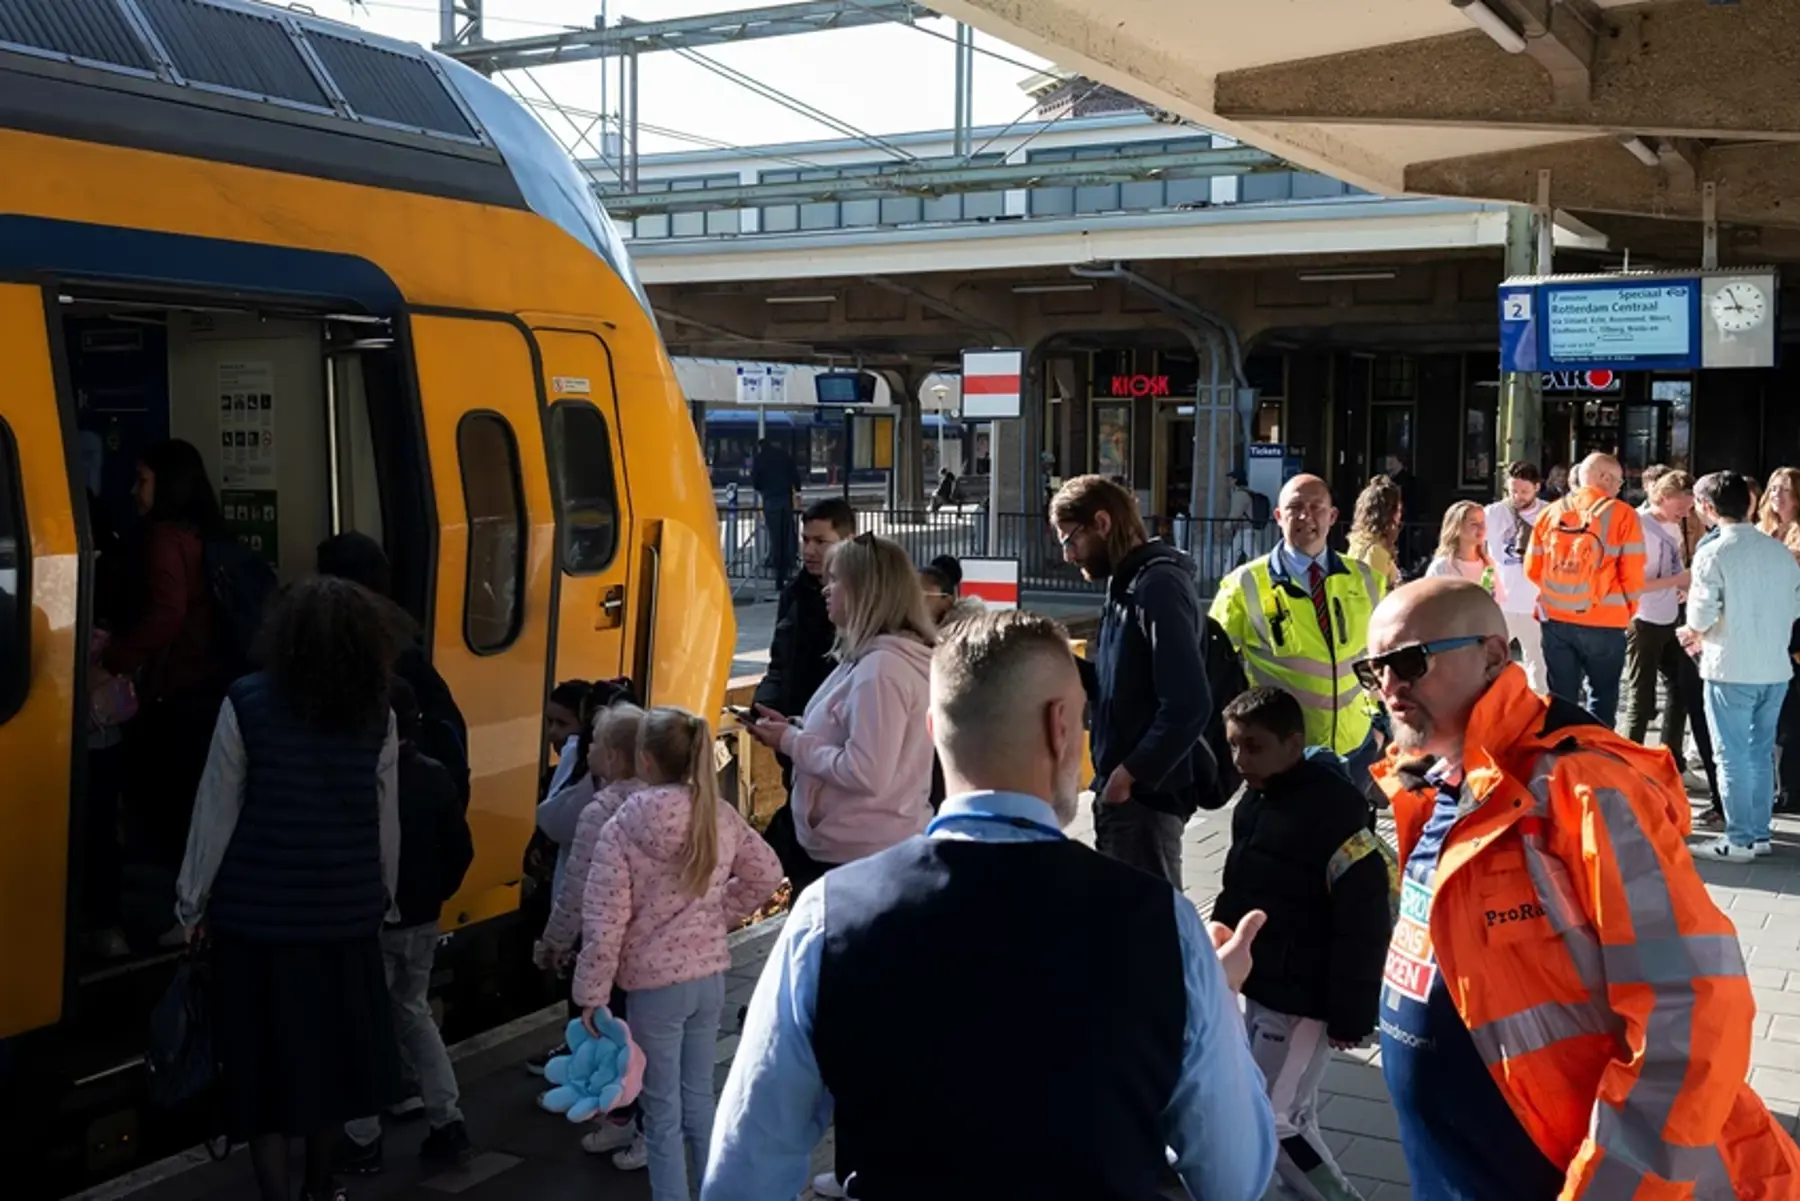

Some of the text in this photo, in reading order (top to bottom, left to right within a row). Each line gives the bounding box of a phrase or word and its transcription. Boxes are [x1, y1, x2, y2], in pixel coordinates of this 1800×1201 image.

[1618, 288, 1662, 301] Speciaal
[1512, 303, 1523, 318] 2
[1552, 300, 1659, 315] Rotterdam Centraal
[1112, 374, 1169, 397] KIOSK
[1249, 446, 1282, 456] Tickets
